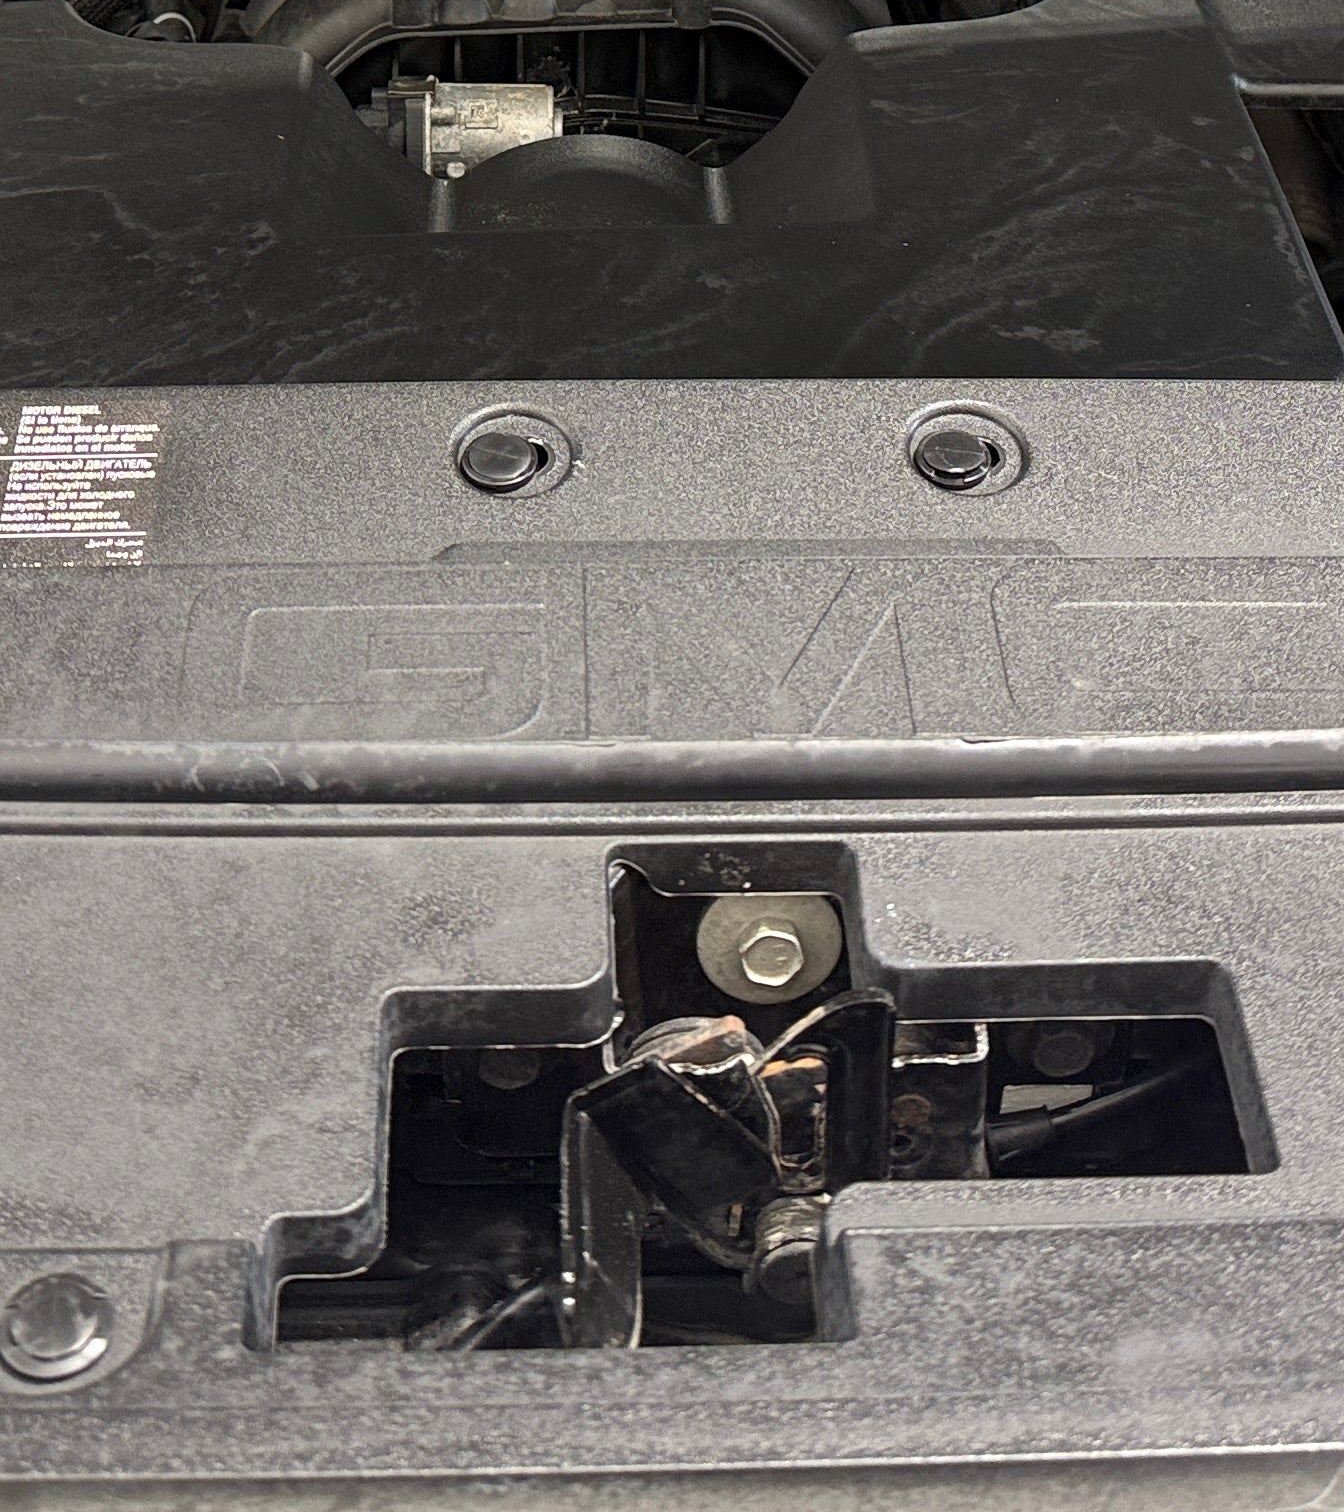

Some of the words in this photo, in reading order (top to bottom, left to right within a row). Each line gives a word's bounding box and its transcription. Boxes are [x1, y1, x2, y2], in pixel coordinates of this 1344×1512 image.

[22, 406, 61, 415] MOTOR
[64, 405, 101, 414] DIESEL
[18, 426, 33, 434] No
[57, 425, 92, 433] fluidos
[94, 425, 108, 433] de
[32, 434, 72, 444] pueden
[74, 434, 119, 444] producir
[75, 444, 89, 452] en
[180, 562, 1331, 740] GMC
